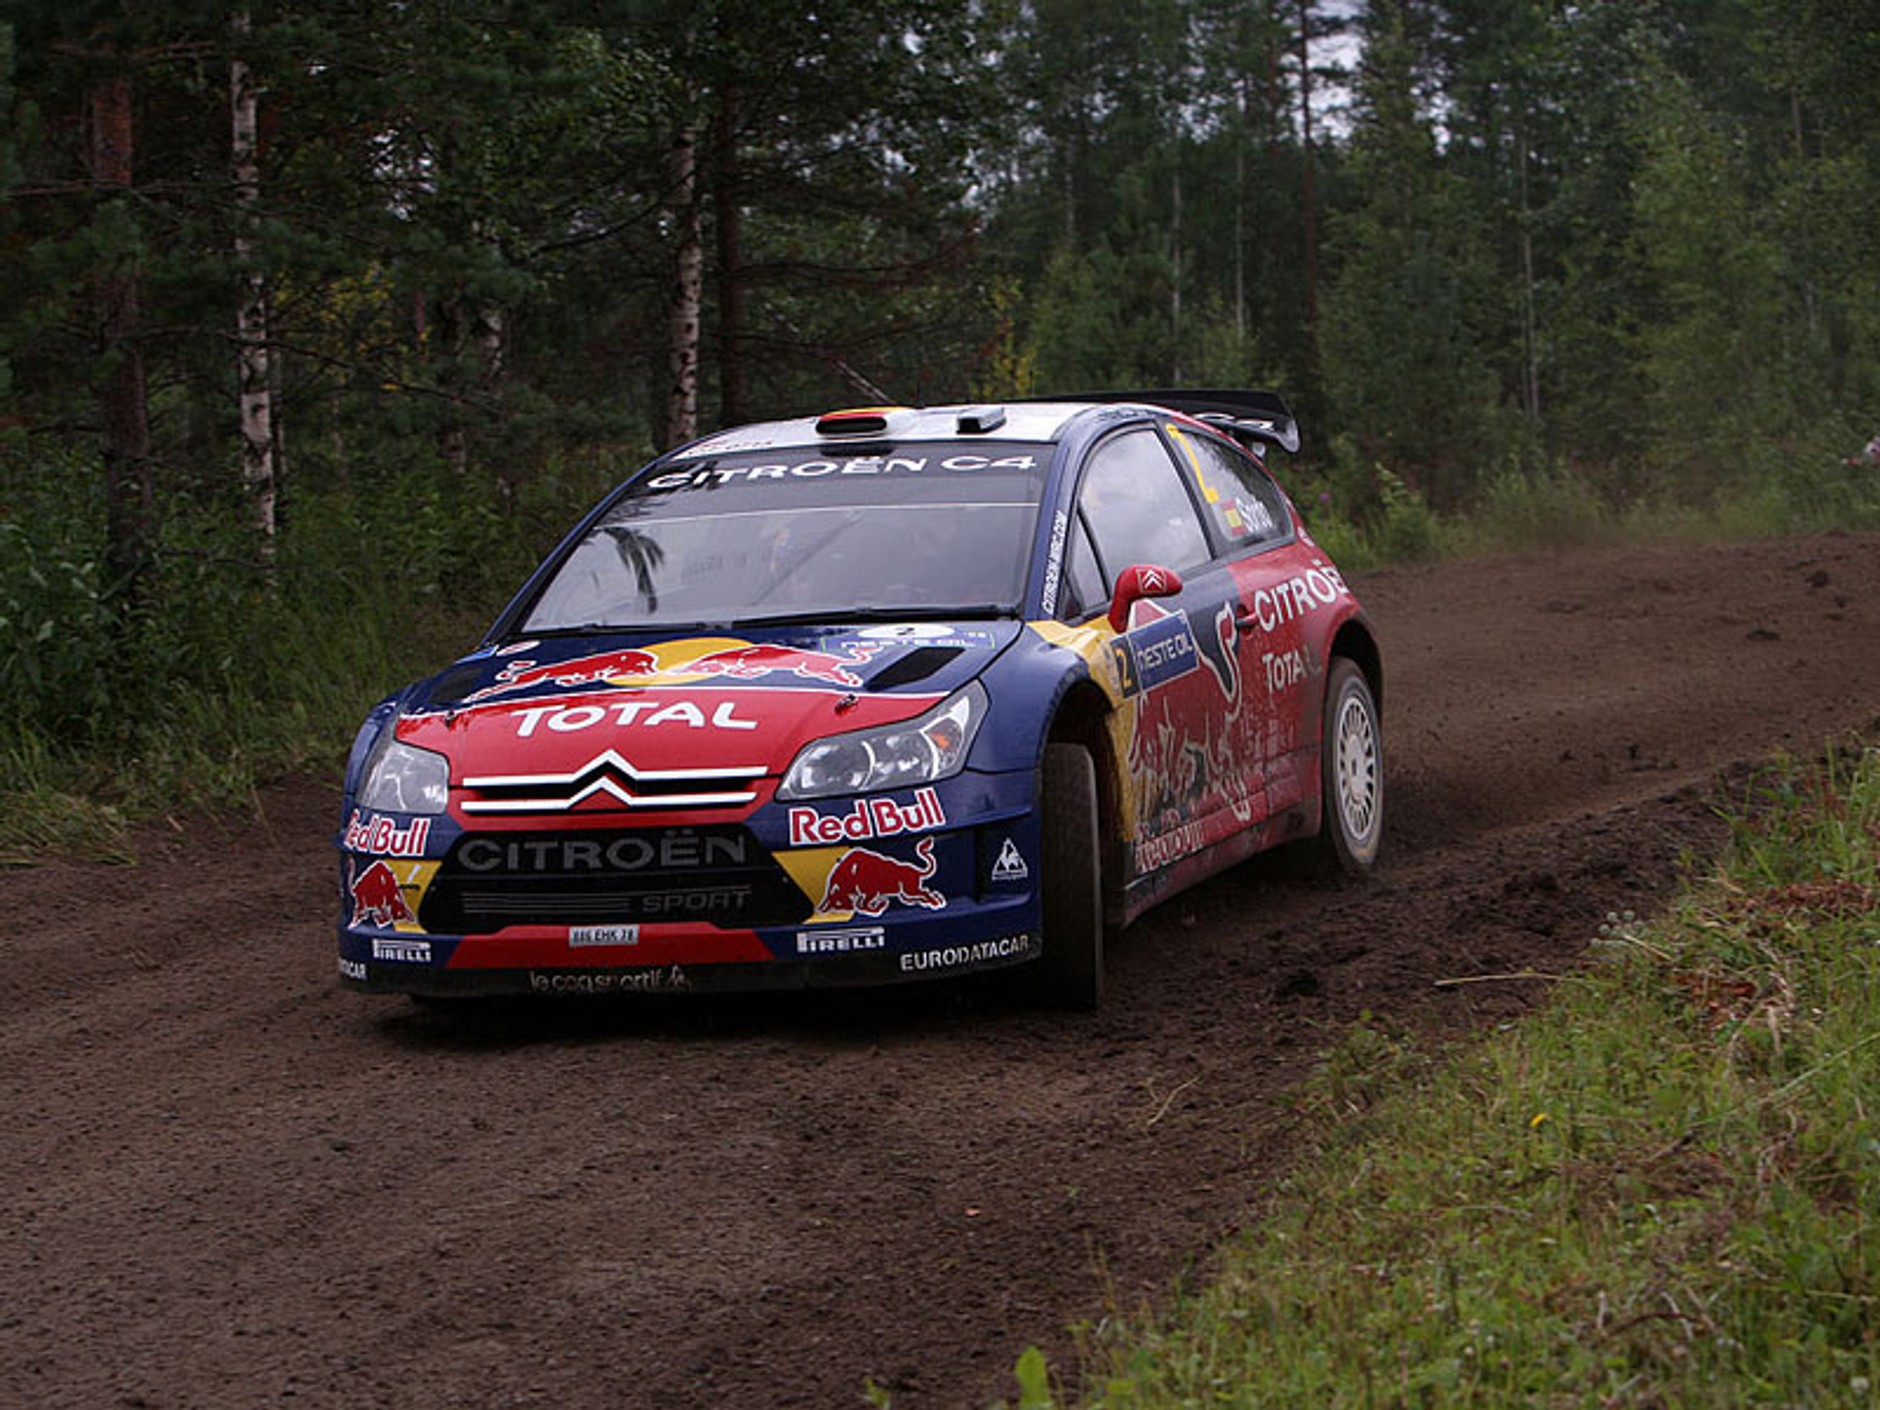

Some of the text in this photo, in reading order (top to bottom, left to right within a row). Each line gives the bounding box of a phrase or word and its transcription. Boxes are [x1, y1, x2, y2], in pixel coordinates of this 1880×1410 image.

[646, 455, 1037, 488] CITROËN C4
[511, 701, 758, 737] TOTAL
[789, 787, 946, 846] Red Bull
[372, 816, 431, 857] Bull
[457, 828, 746, 871] CITROËN
[641, 890, 752, 913] SPORT
[372, 938, 432, 962] PIRELLI
[796, 926, 886, 953] PIRELLI
[899, 934, 1030, 971] EURODATACAR
